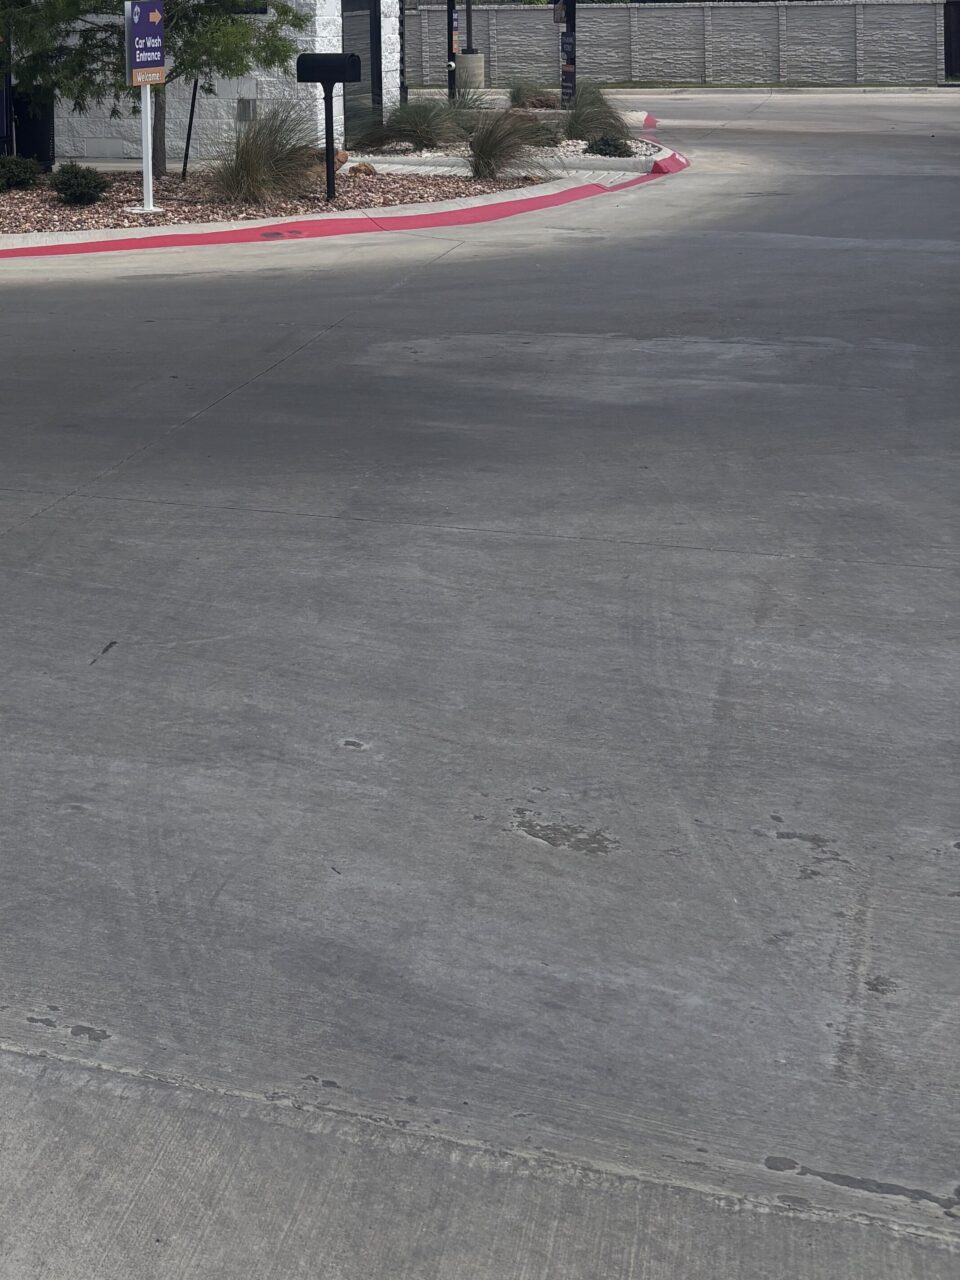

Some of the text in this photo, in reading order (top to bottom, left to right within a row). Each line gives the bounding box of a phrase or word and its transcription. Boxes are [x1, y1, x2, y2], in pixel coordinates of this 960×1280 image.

[134, 35, 162, 49] Car Wash
[136, 50, 161, 62] Entrance
